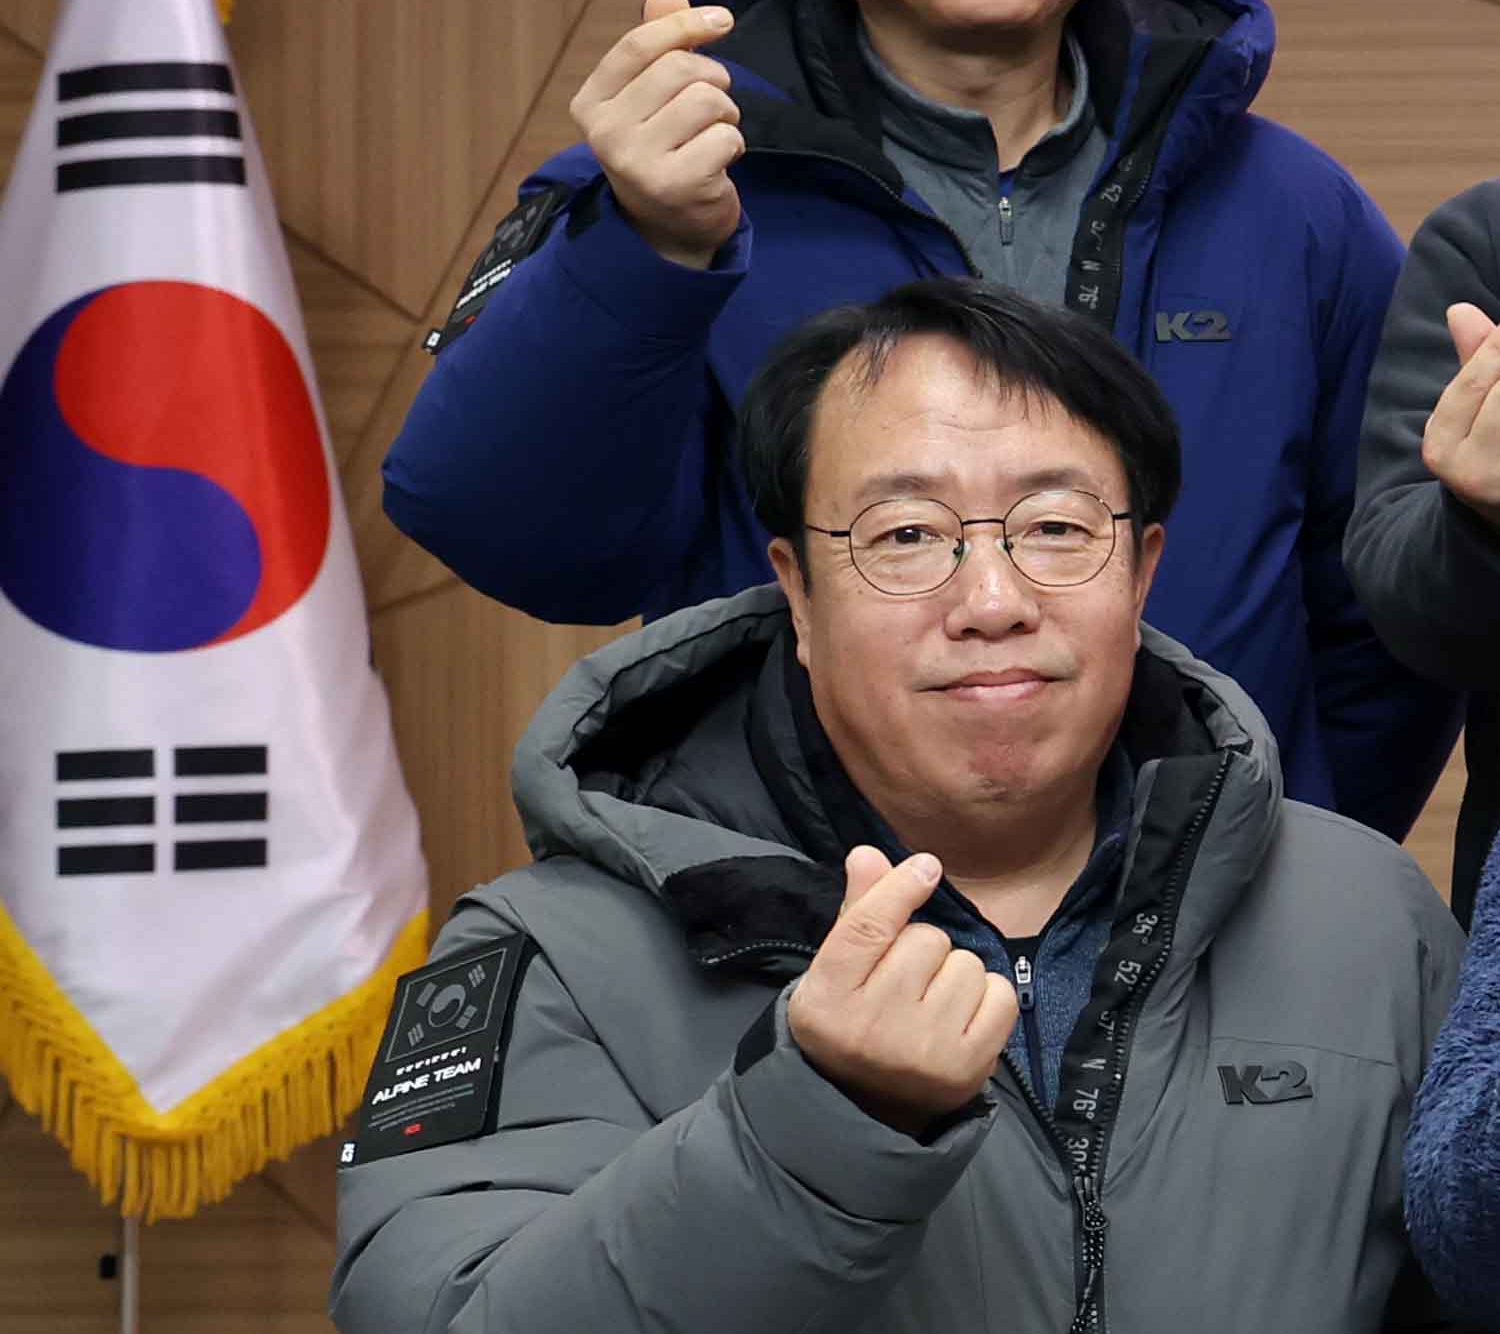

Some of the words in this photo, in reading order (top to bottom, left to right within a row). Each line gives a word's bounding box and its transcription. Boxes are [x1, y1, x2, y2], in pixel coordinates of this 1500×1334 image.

[1154, 312, 1233, 344] K2
[371, 1074, 431, 1106] ALPINE
[432, 1057, 482, 1083] TEAM
[1081, 1057, 1108, 1072] N
[1216, 1060, 1314, 1106] K2
